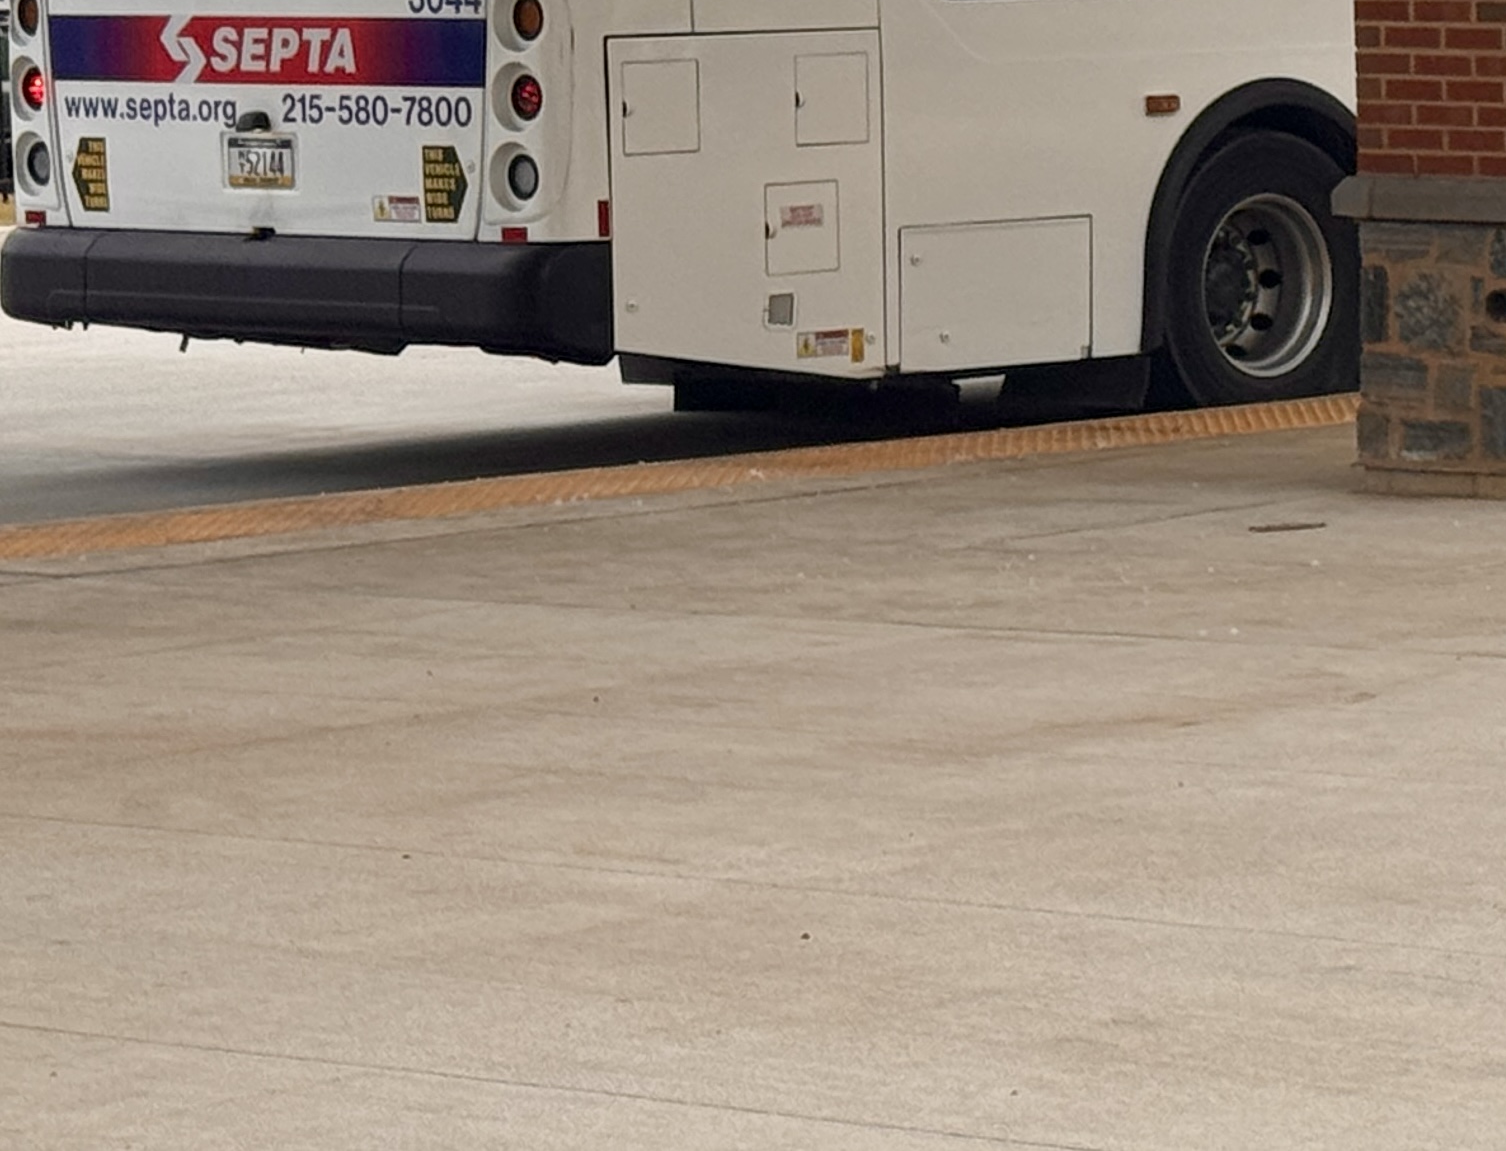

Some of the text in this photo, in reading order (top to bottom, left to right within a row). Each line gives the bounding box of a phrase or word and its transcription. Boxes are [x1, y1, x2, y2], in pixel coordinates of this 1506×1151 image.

[210, 27, 357, 74] SEPTA
[65, 93, 472, 128] www.septa.org 215-580-7800
